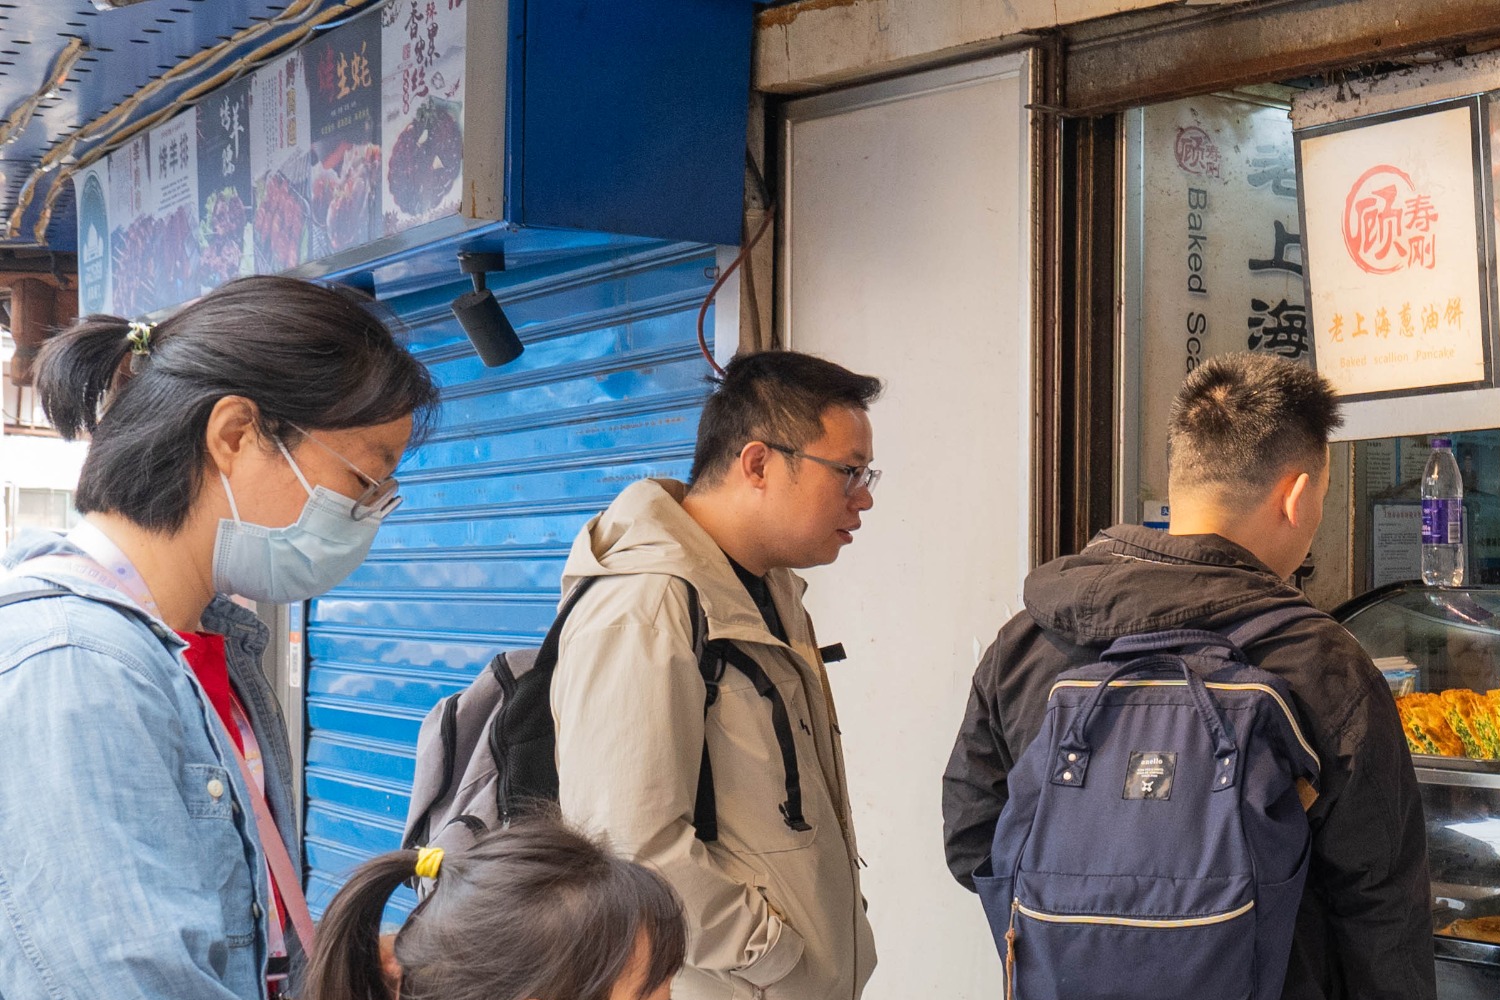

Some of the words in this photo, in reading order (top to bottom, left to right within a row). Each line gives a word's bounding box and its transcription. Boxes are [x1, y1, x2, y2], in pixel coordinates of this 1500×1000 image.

[1188, 187, 1208, 294] Baked
[1328, 298, 1464, 343] 老上海葱油饼
[1340, 355, 1367, 369] Baked
[1374, 350, 1408, 364] scallion
